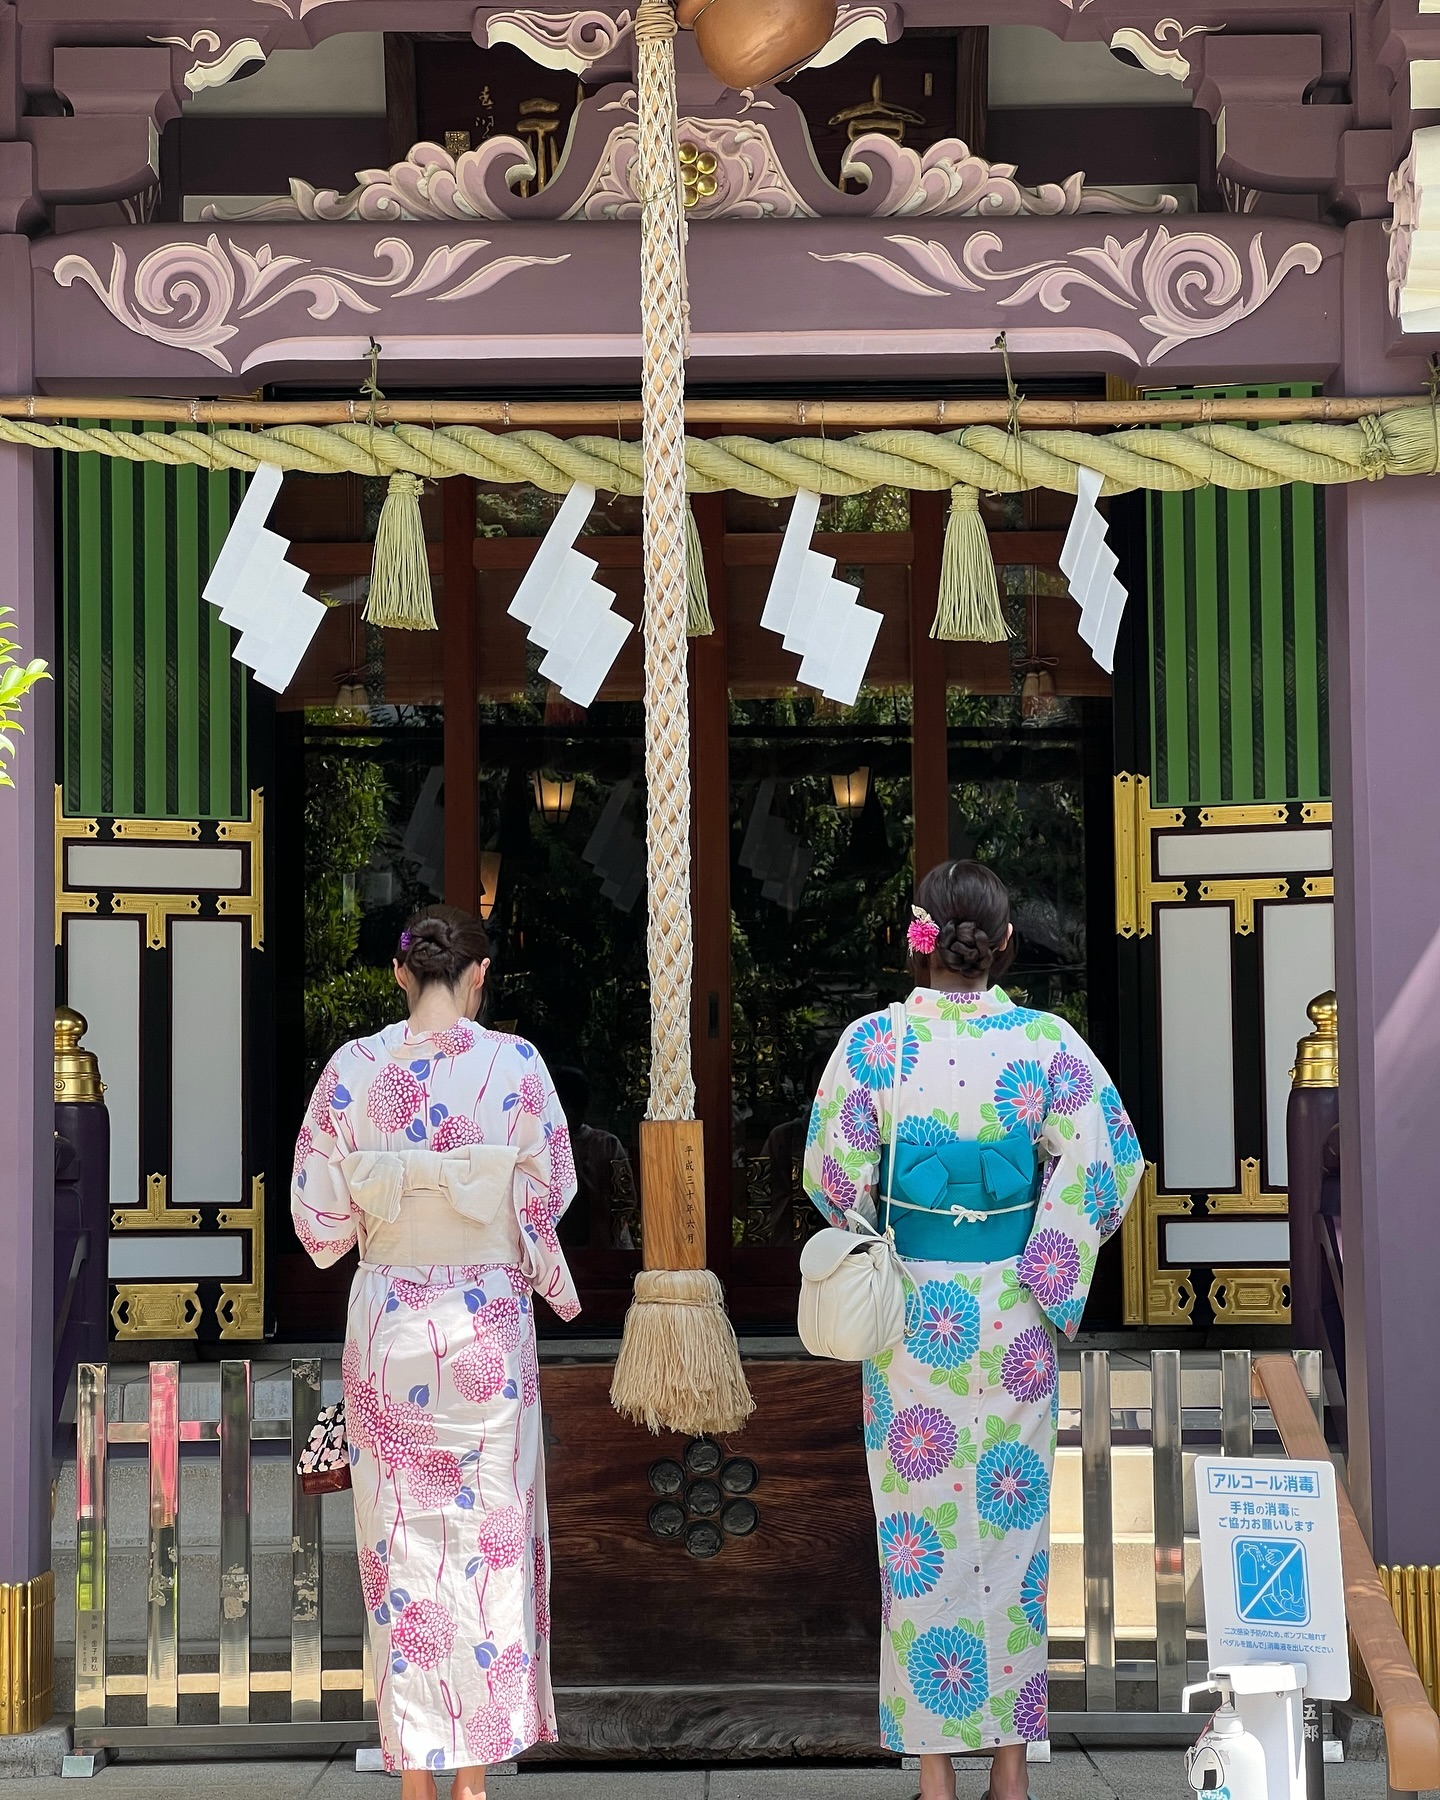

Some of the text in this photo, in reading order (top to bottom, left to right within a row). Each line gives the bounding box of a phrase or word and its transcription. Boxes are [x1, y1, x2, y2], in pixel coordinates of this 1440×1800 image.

[684, 1145, 696, 1244] 平成三十年六月
[1213, 1473, 1314, 1493] アルコール消毒
[1230, 1501, 1300, 1517] 手指の消毒に
[1218, 1517, 1315, 1532] ご協力お願いします
